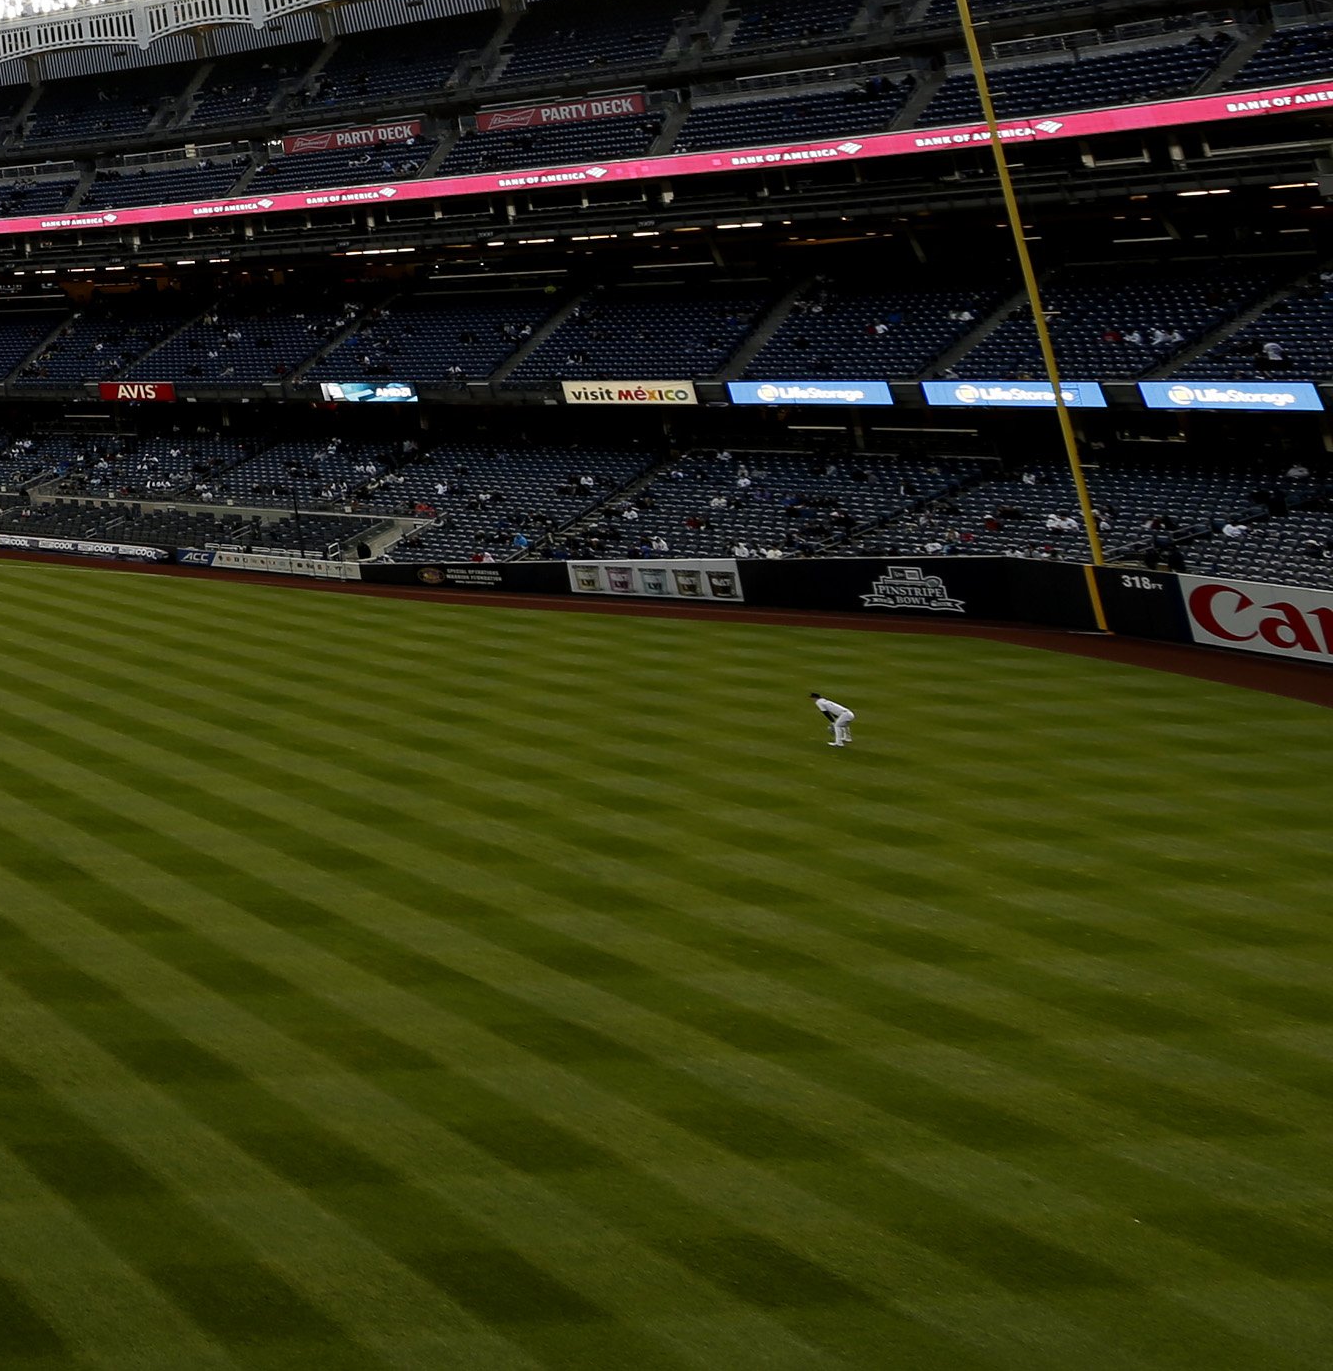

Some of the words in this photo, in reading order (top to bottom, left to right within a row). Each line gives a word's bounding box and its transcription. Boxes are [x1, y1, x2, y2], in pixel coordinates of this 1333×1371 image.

[541, 105, 588, 122] PARTY
[592, 98, 634, 116] DECK
[1227, 100, 1271, 111] BANK
[1273, 97, 1291, 106] OF
[336, 130, 375, 145] PARTY
[378, 125, 412, 141] DECK
[916, 137, 951, 146] BANK
[953, 134, 969, 142] OF
[732, 156, 764, 164] BANK
[784, 147, 839, 160] AMERICA
[499, 178, 527, 186] BANK
[541, 173, 585, 182] AMERICA
[342, 191, 380, 200] AMERICA
[225, 202, 259, 211] AMERICA
[117, 385, 156, 399] AVIS
[571, 387, 614, 400] visit
[980, 386, 1073, 401] LifeStorae
[10, 538, 30, 548] COOL
[53, 541, 74, 551] COOL
[94, 544, 115, 554] COOL
[135, 548, 157, 560] COOL
[183, 552, 209, 562] ACC
[877, 585, 944, 598] PINSTRIPE
[896, 596, 929, 606] BOWL
